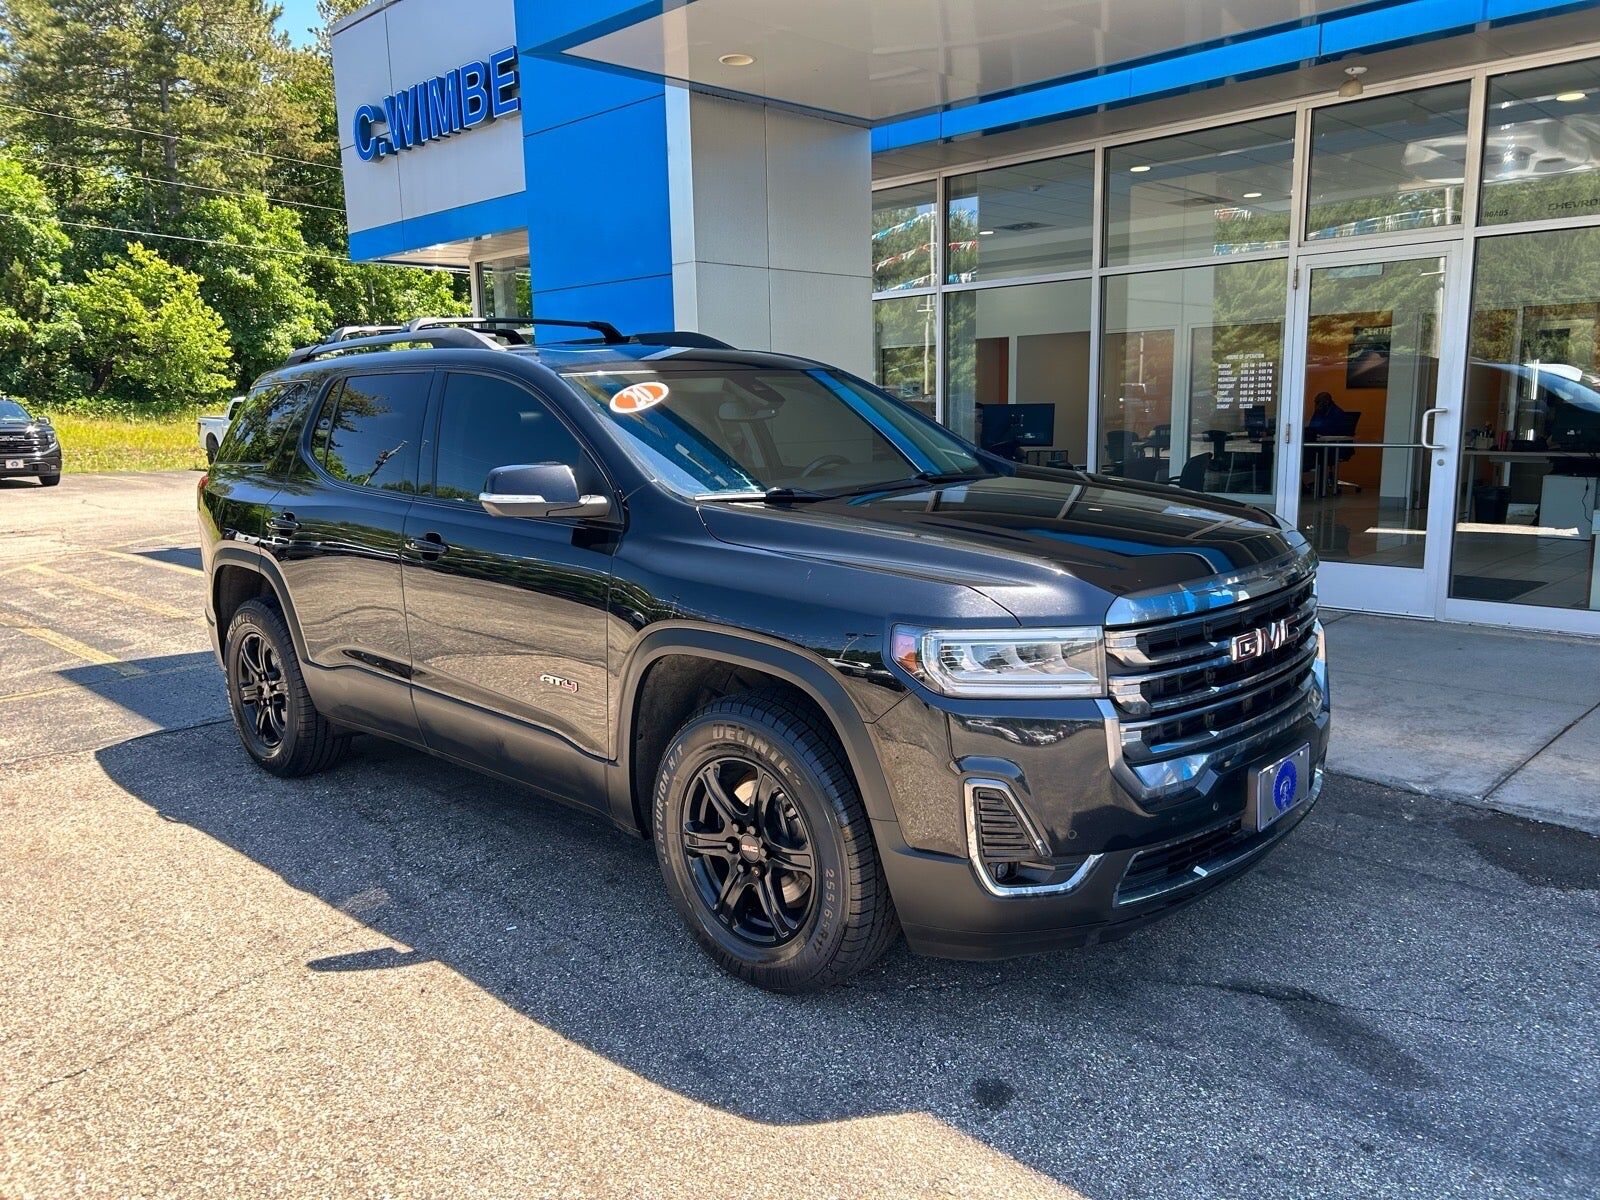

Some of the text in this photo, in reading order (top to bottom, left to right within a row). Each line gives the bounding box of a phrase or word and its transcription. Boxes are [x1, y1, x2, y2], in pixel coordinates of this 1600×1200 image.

[1548, 198, 1600, 211] CHEVRO
[1231, 614, 1300, 664] GMC
[540, 674, 579, 694] AT4
